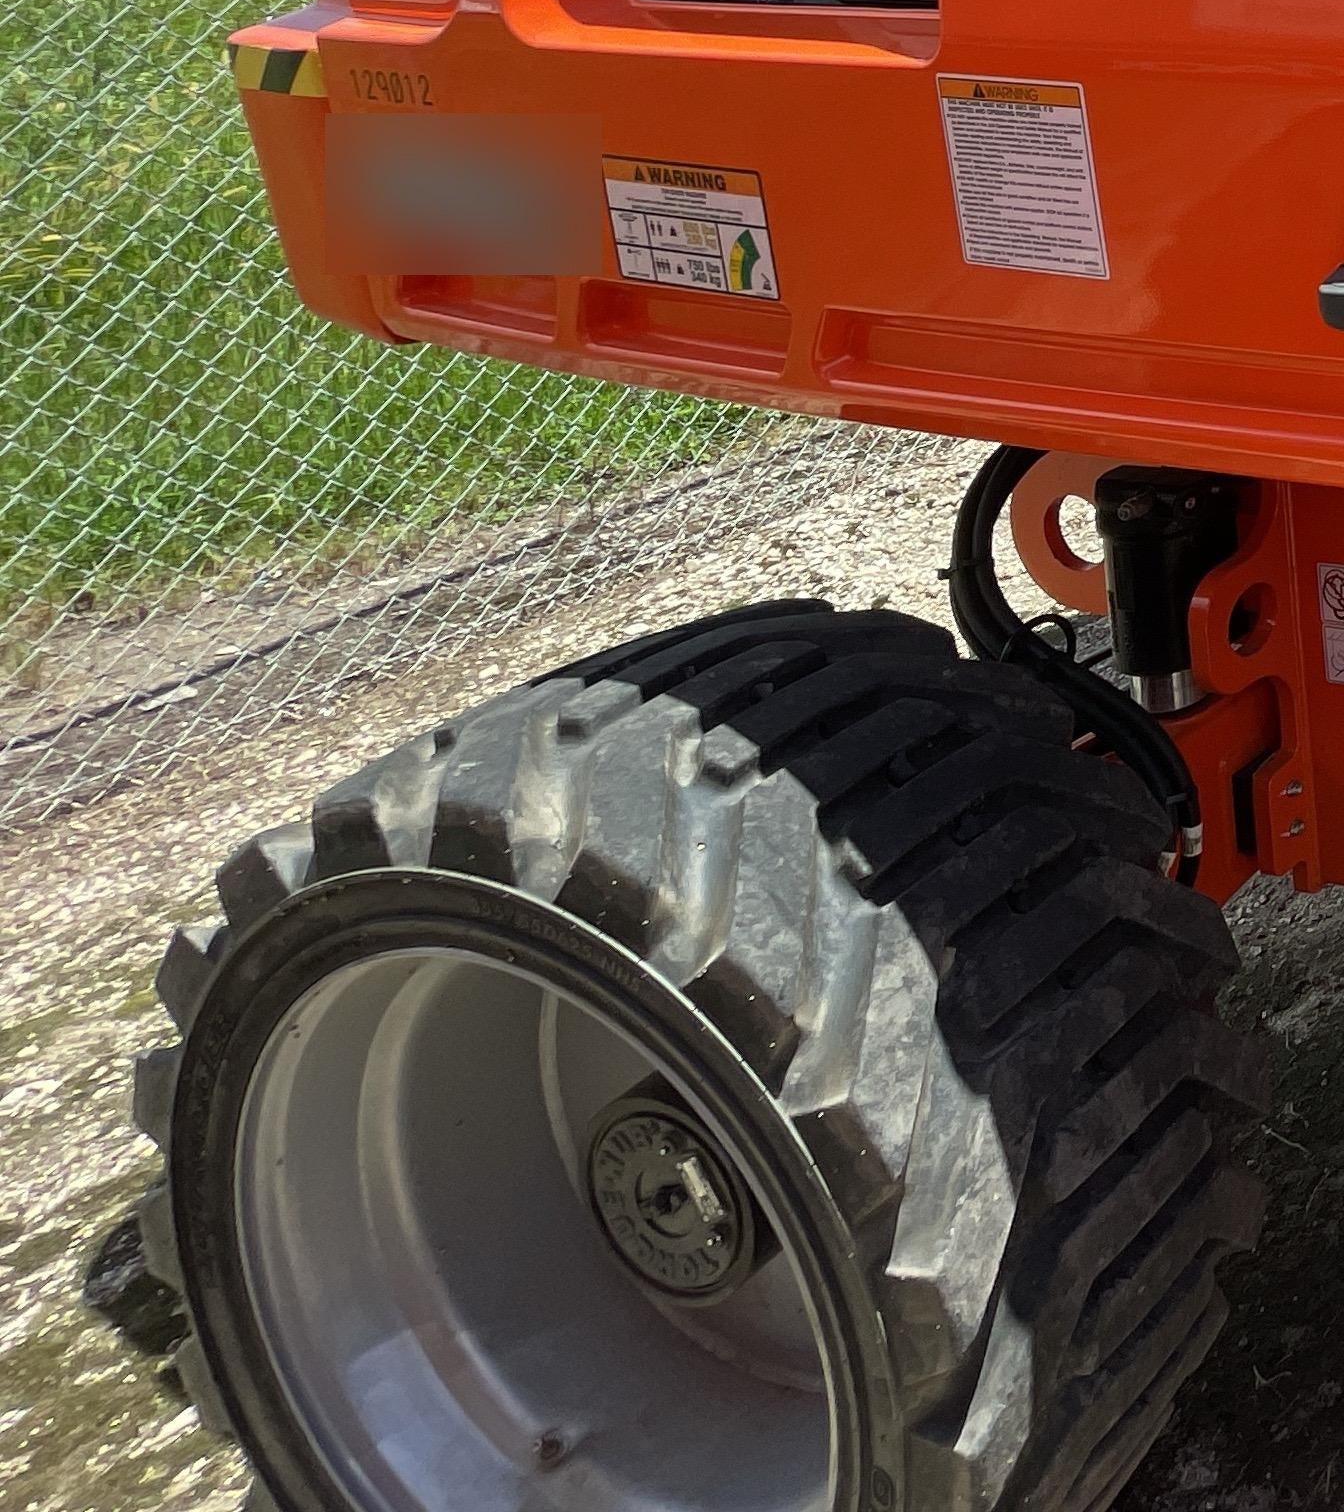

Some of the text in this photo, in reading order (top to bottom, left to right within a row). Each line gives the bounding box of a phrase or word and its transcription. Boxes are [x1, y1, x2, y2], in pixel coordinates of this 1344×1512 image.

[349, 69, 434, 107] 129012
[984, 85, 1040, 103] WARNING
[647, 165, 727, 191] WARNING
